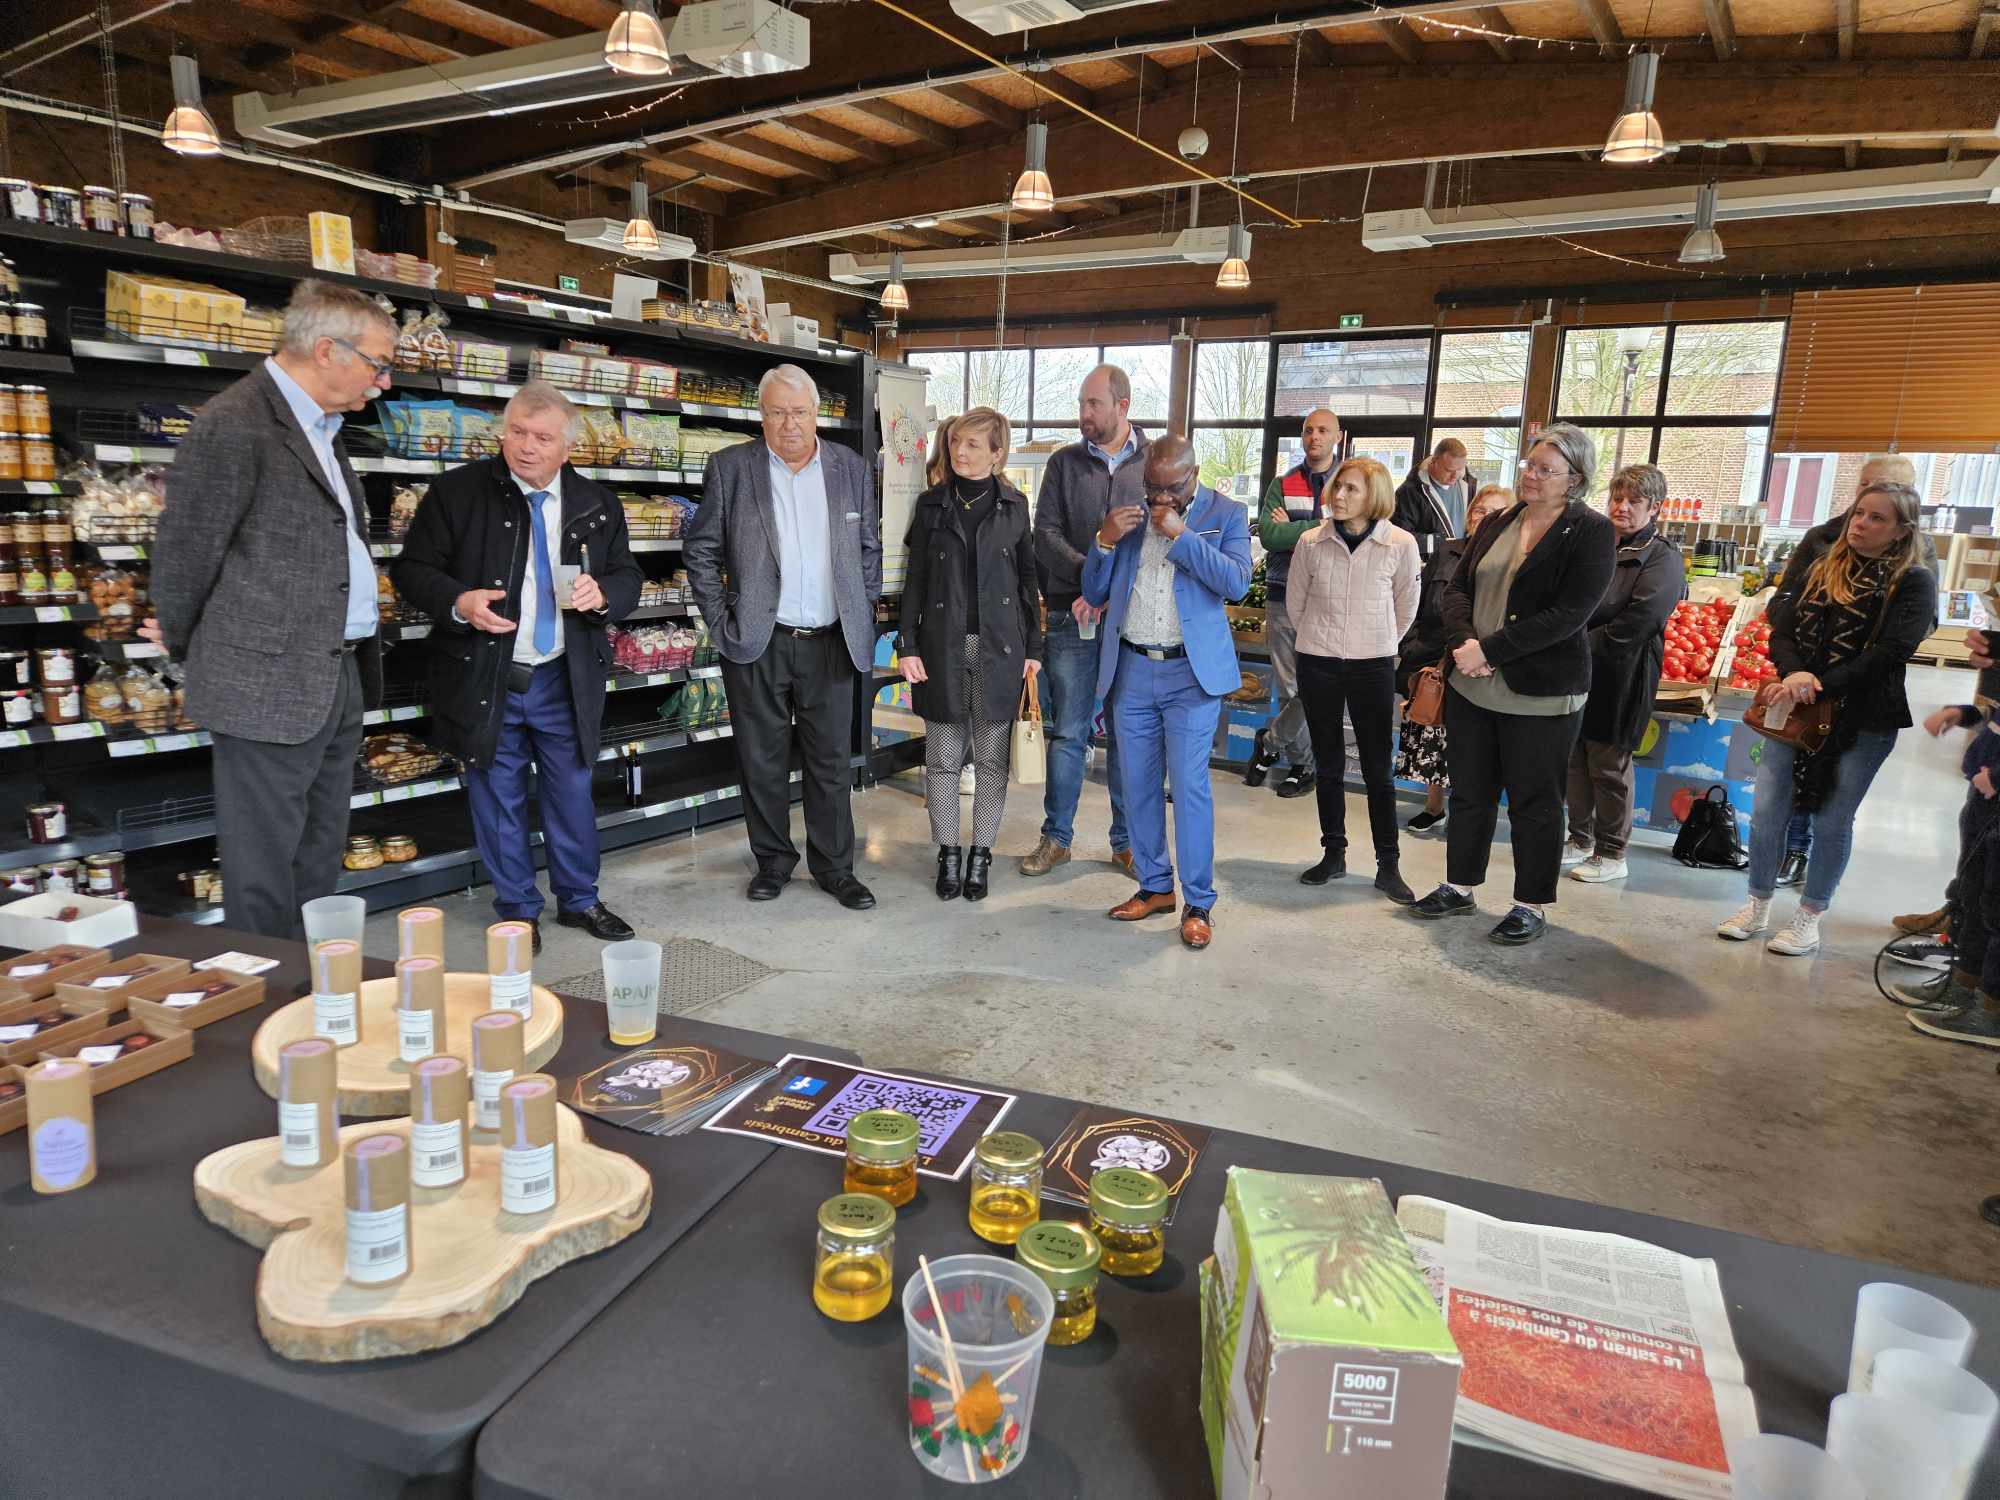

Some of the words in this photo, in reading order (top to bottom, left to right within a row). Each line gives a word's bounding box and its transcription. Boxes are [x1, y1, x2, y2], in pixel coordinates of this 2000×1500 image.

[742, 1119, 820, 1142] Cambrésis
[823, 1136, 844, 1146] du
[1456, 1293, 1527, 1317] assiettes
[1469, 1309, 1481, 1323] à
[1530, 1308, 1562, 1323] nos
[1484, 1313, 1570, 1344] Cambrésis
[1565, 1317, 1589, 1333] de
[1575, 1333, 1597, 1350] du
[1593, 1324, 1673, 1352] conquête
[1602, 1340, 1659, 1364] safran
[1679, 1345, 1696, 1360] la
[1663, 1356, 1683, 1371] Le
[1343, 1372, 1387, 1391] 5000
